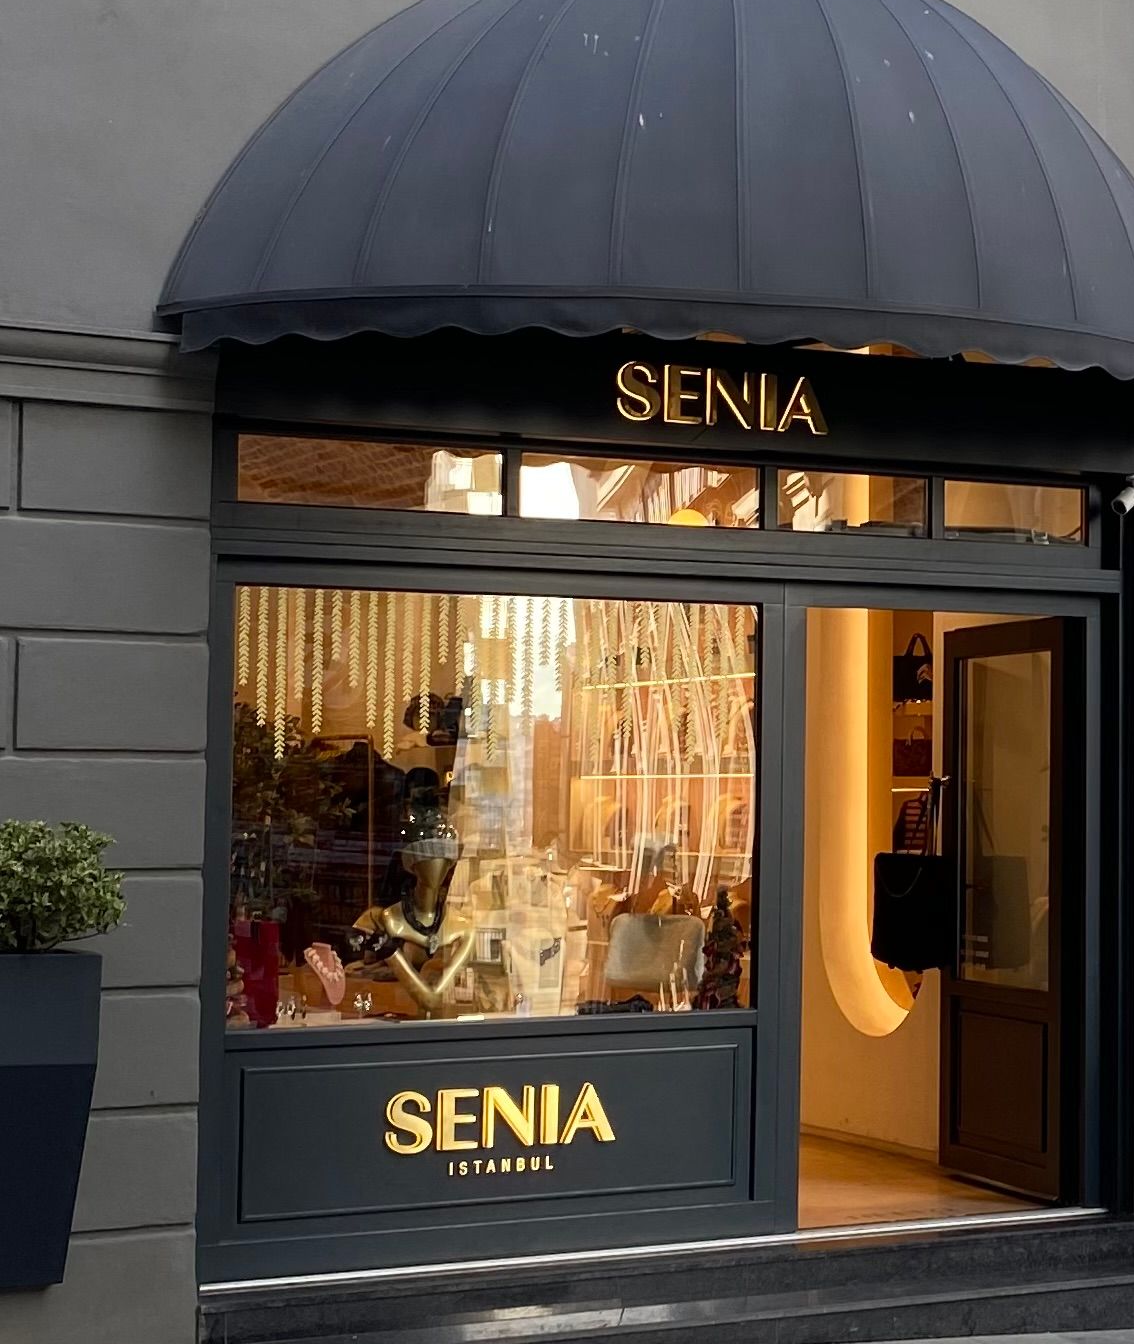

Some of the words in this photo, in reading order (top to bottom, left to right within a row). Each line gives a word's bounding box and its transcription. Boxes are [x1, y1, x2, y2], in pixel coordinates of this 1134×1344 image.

[616, 360, 829, 436] SENIA
[384, 1082, 616, 1154] SENIA
[448, 1155, 554, 1176] ISTANBUL
